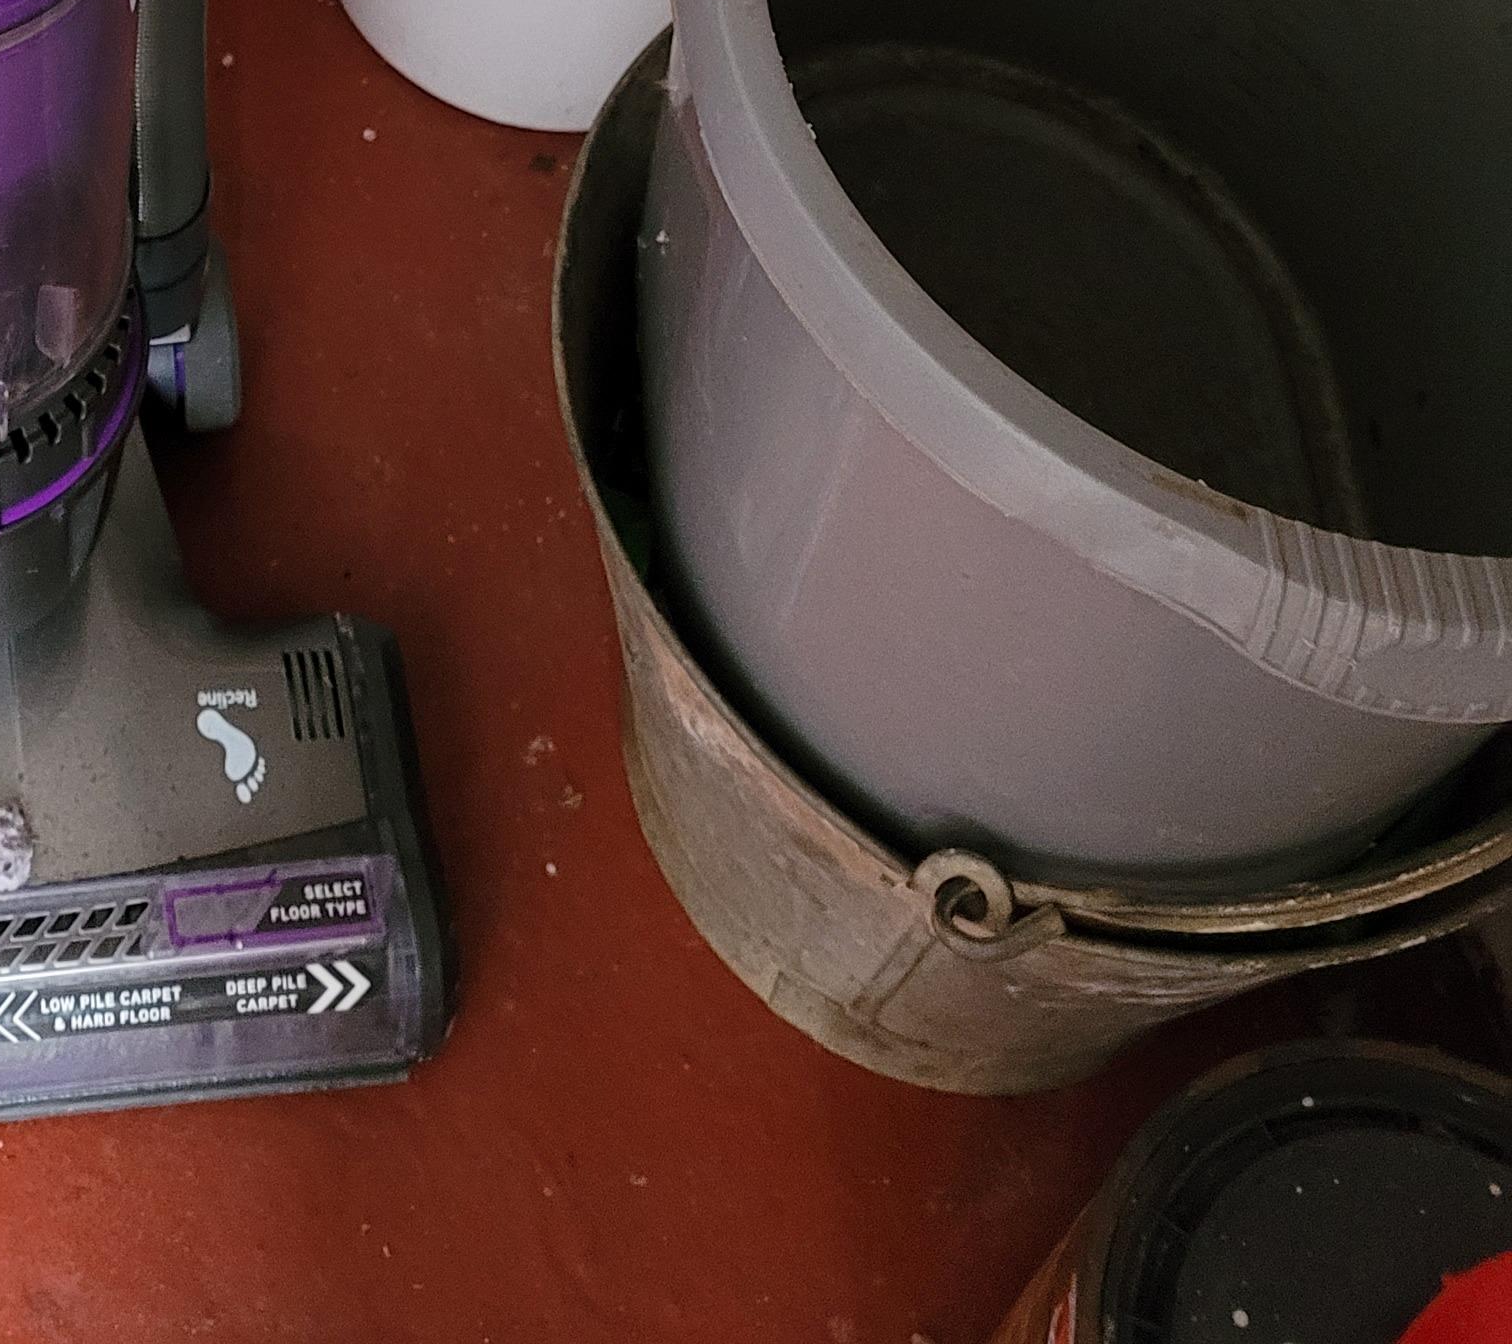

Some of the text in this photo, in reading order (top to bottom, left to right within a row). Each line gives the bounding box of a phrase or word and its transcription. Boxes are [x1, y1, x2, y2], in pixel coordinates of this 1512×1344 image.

[197, 687, 257, 709] Recline
[304, 879, 362, 900] SELECT
[270, 899, 366, 923] FLOOR TYPE
[225, 973, 307, 996] DEEP PILE
[40, 985, 182, 1014] LOW PILE CARPET
[236, 993, 299, 1013] CARPET
[71, 1012, 115, 1030] HARD
[119, 1006, 171, 1025] FLOOR
